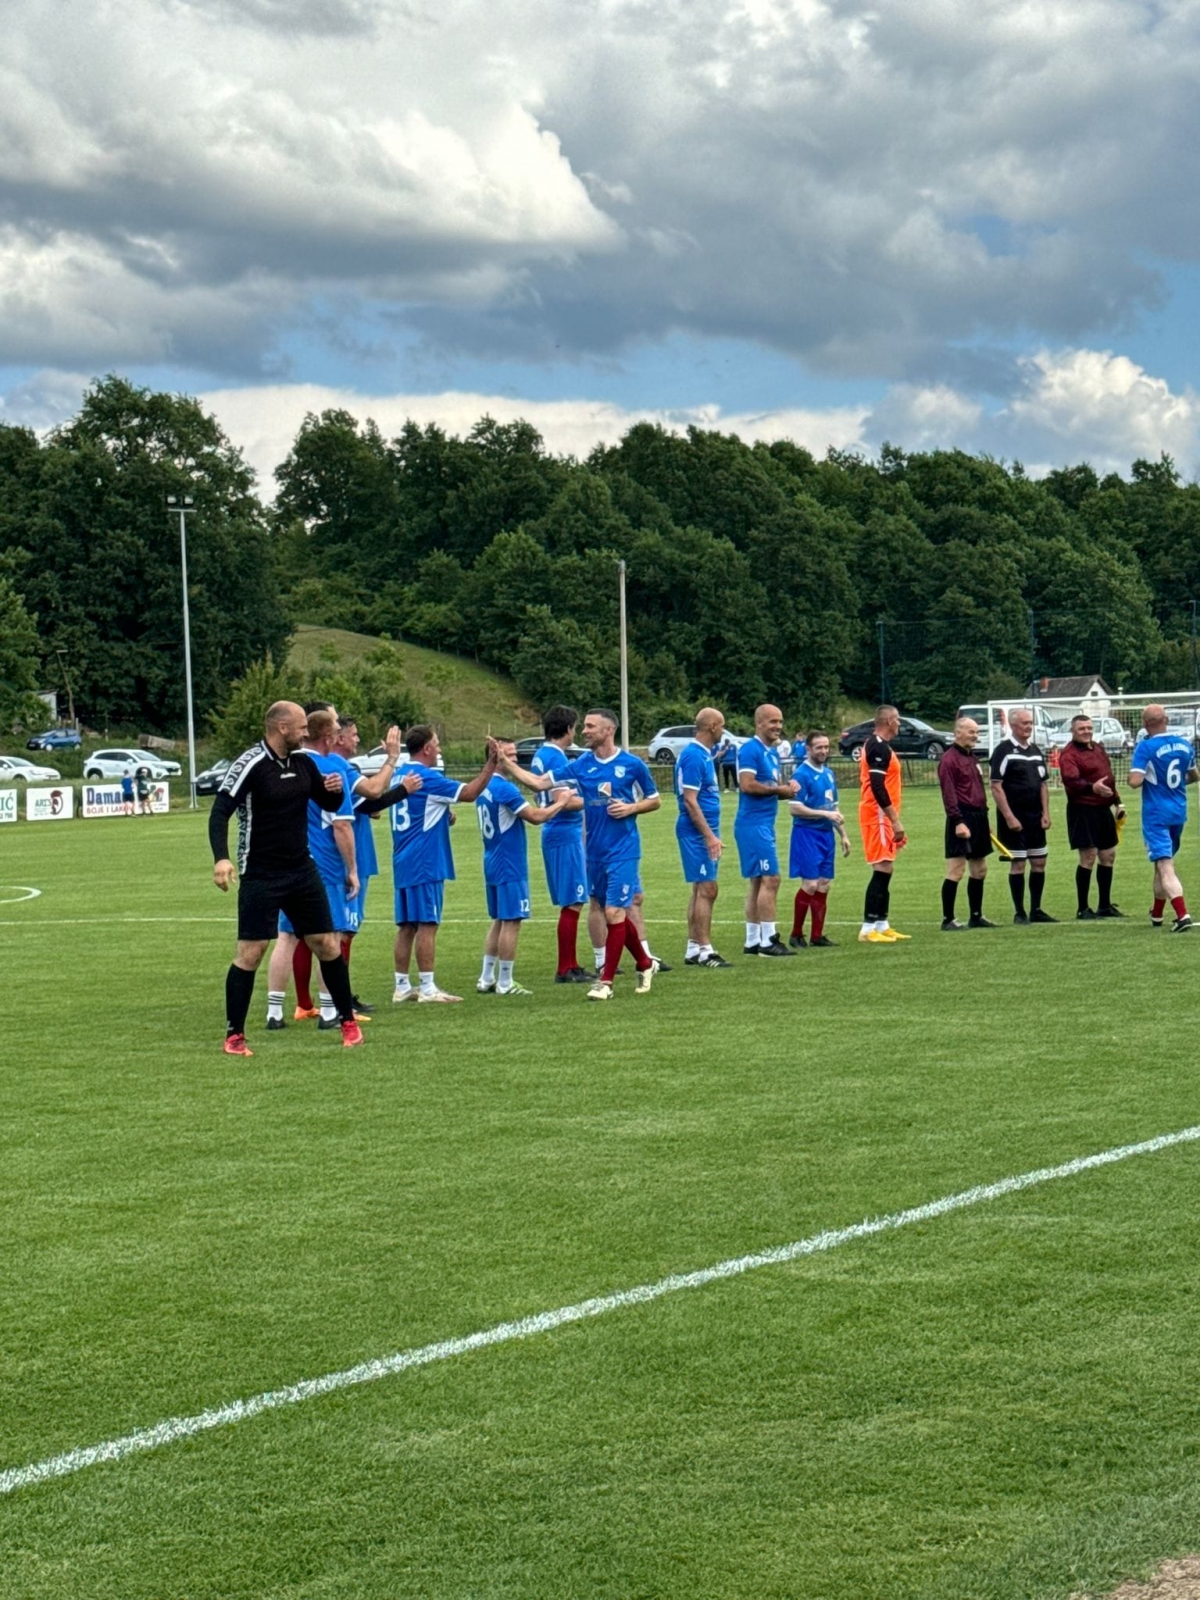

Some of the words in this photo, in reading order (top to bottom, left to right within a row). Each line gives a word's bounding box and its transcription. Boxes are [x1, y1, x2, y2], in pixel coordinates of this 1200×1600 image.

[1166, 758, 1181, 789] 6
[477, 804, 495, 840] 18
[699, 864, 707, 877] 4
[759, 859, 770, 871] 16
[577, 884, 584, 897] 9
[520, 899, 530, 912] 12
